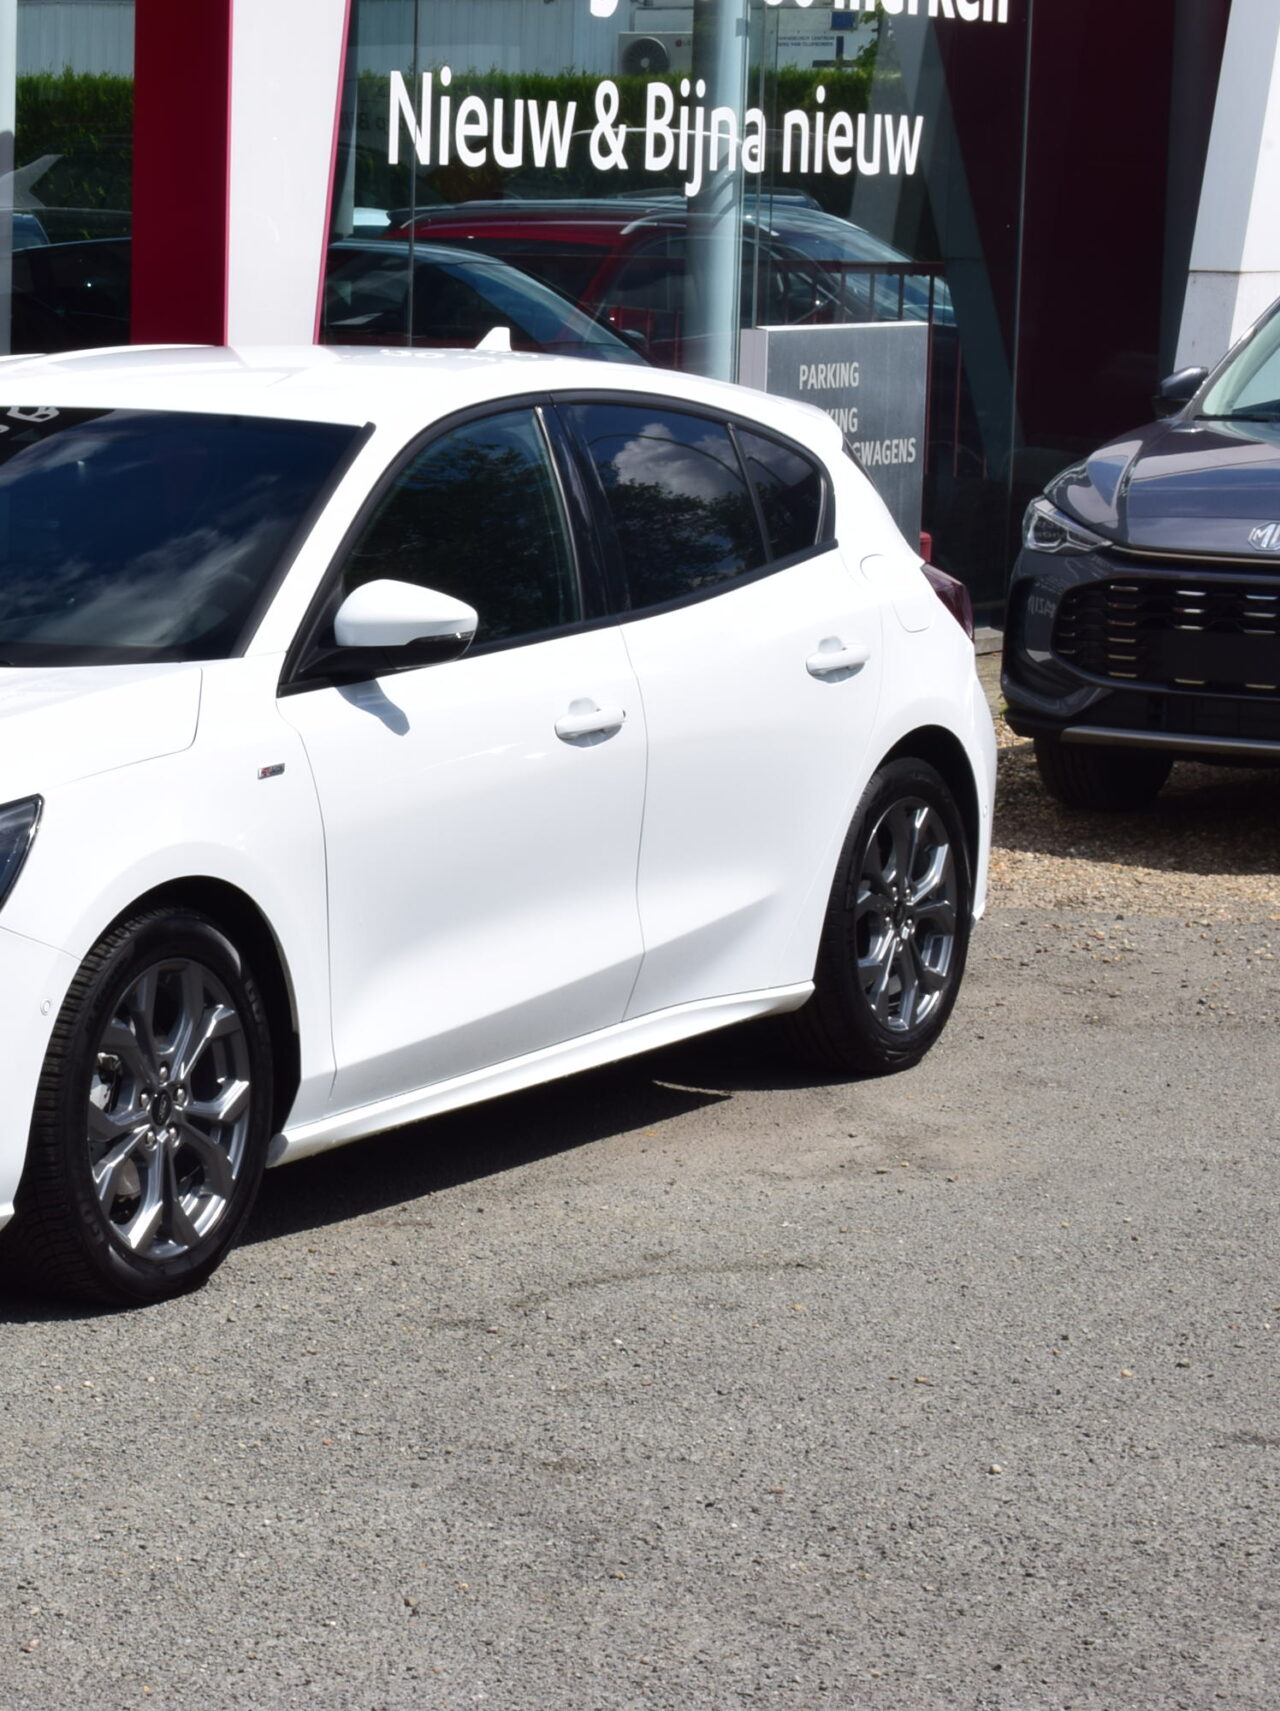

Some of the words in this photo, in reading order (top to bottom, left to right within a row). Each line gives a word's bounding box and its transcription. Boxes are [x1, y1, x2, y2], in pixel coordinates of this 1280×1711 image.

[388, 66, 576, 168] Nieuw
[589, 80, 628, 171] &
[644, 78, 766, 197] Bijna
[782, 85, 924, 176] nieuw
[799, 362, 859, 390] PARKING
